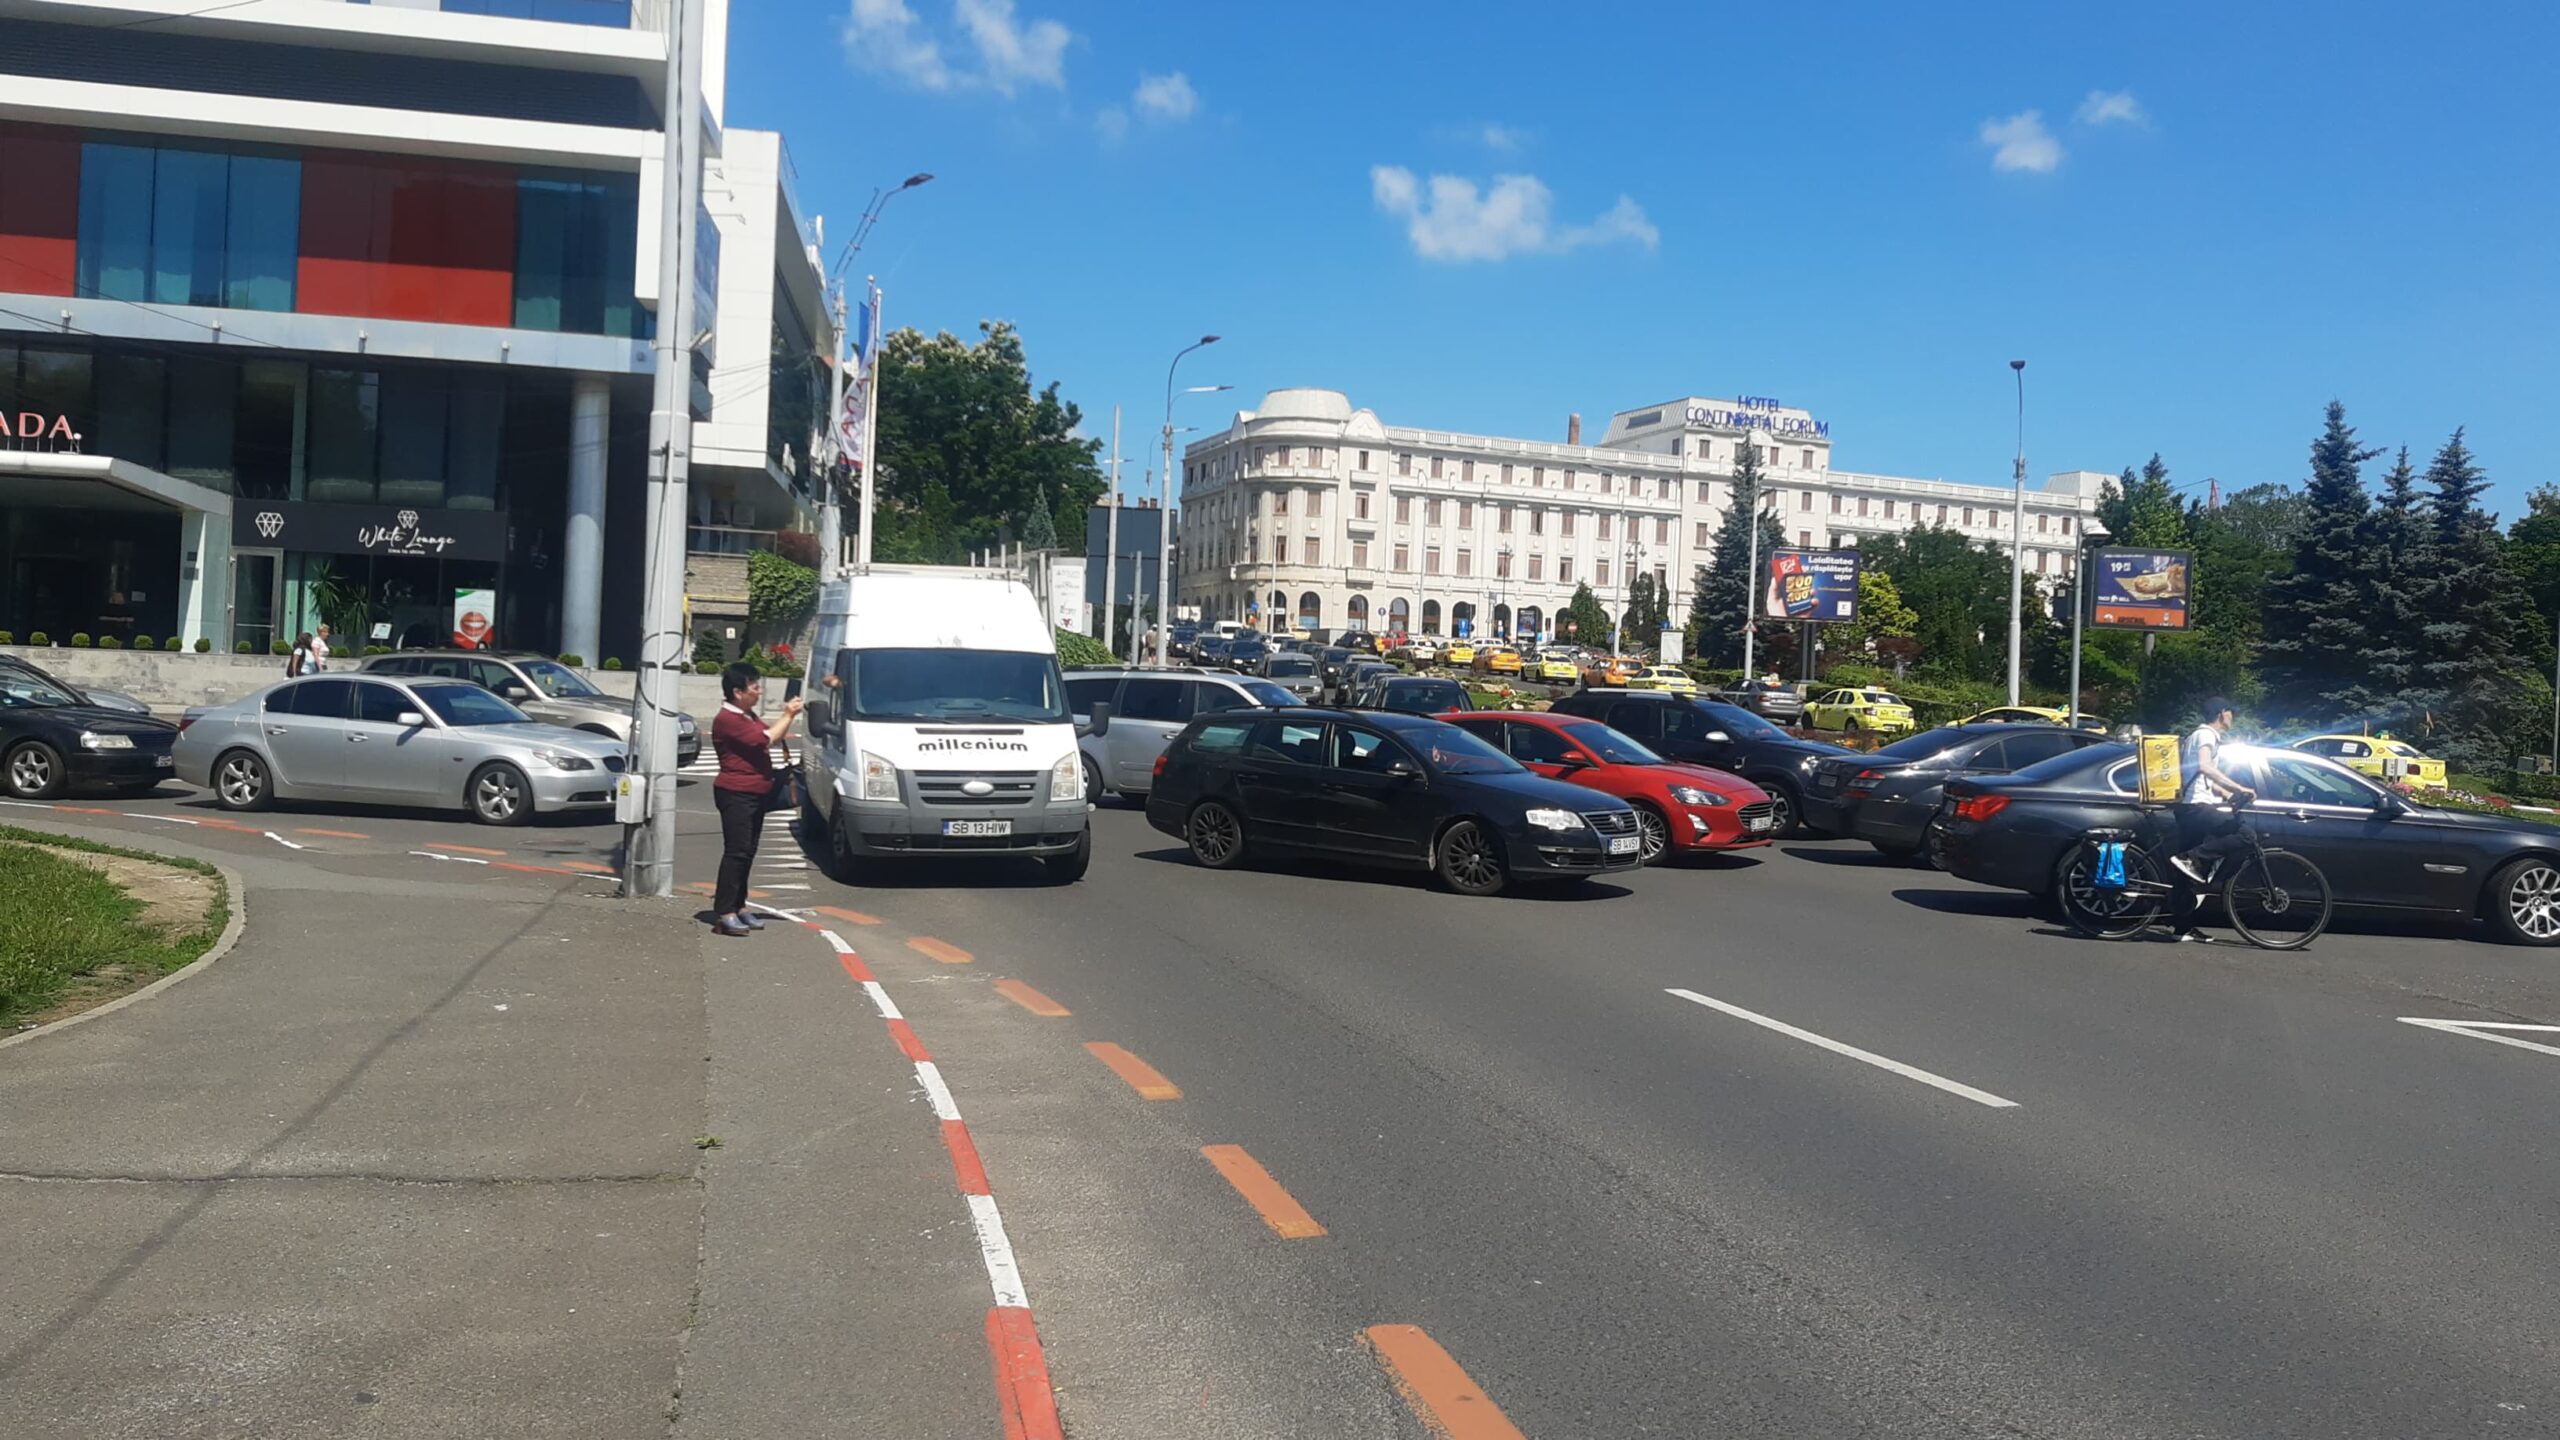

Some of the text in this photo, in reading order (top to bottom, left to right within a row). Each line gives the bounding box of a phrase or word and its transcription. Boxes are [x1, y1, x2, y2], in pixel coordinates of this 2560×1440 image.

[1737, 395, 1782, 413] HOTEL
[1685, 406, 1829, 438] CONTINENTAL FORUM
[358, 525, 456, 552] White Lounge
[1807, 555, 1854, 565] Loialitatea
[918, 738, 1028, 752] millenium
[2160, 748, 2170, 781] Glovo
[952, 823, 1007, 834] SB 13 HIW
[1613, 839, 1622, 850] SB
